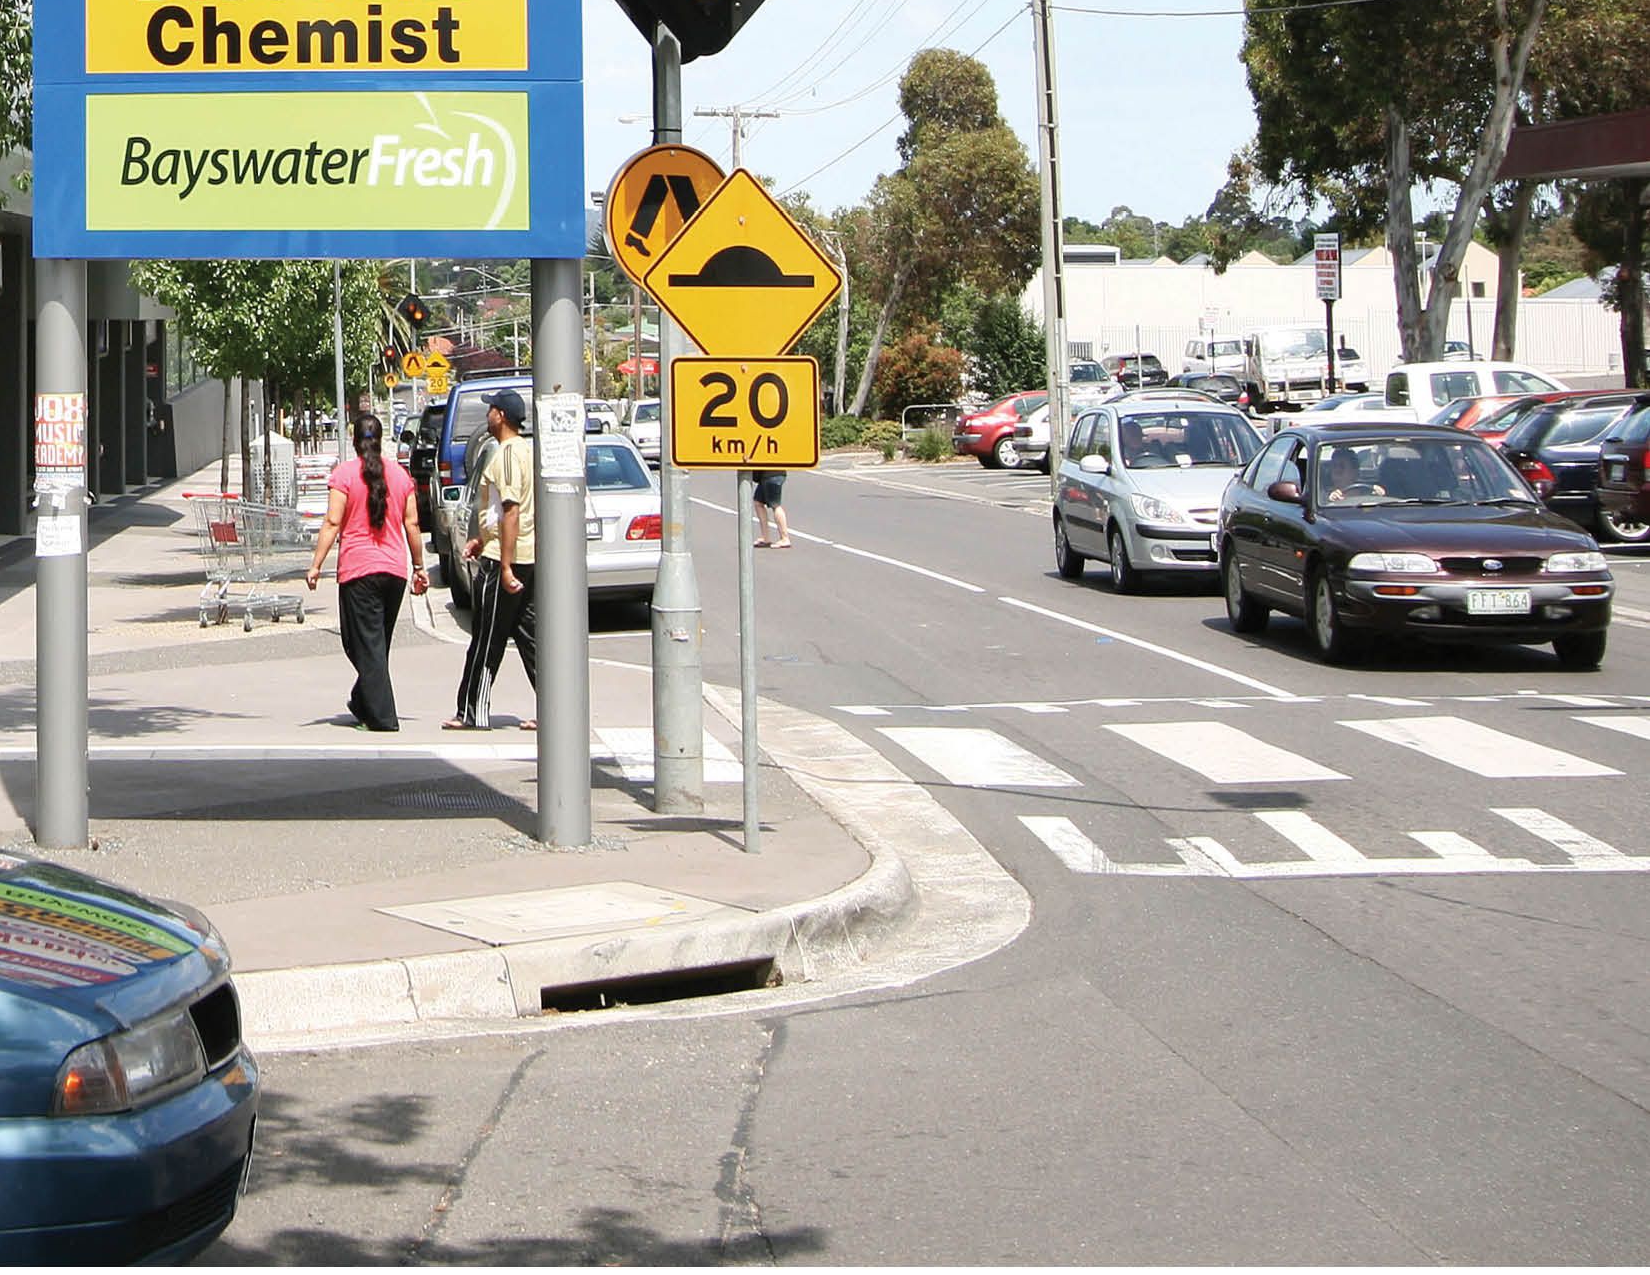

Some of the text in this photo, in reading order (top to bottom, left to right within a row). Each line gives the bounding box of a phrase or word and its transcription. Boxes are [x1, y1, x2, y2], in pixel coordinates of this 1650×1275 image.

[147, 4, 461, 66] Chemist
[698, 371, 789, 429] 20
[712, 435, 779, 459] km/h
